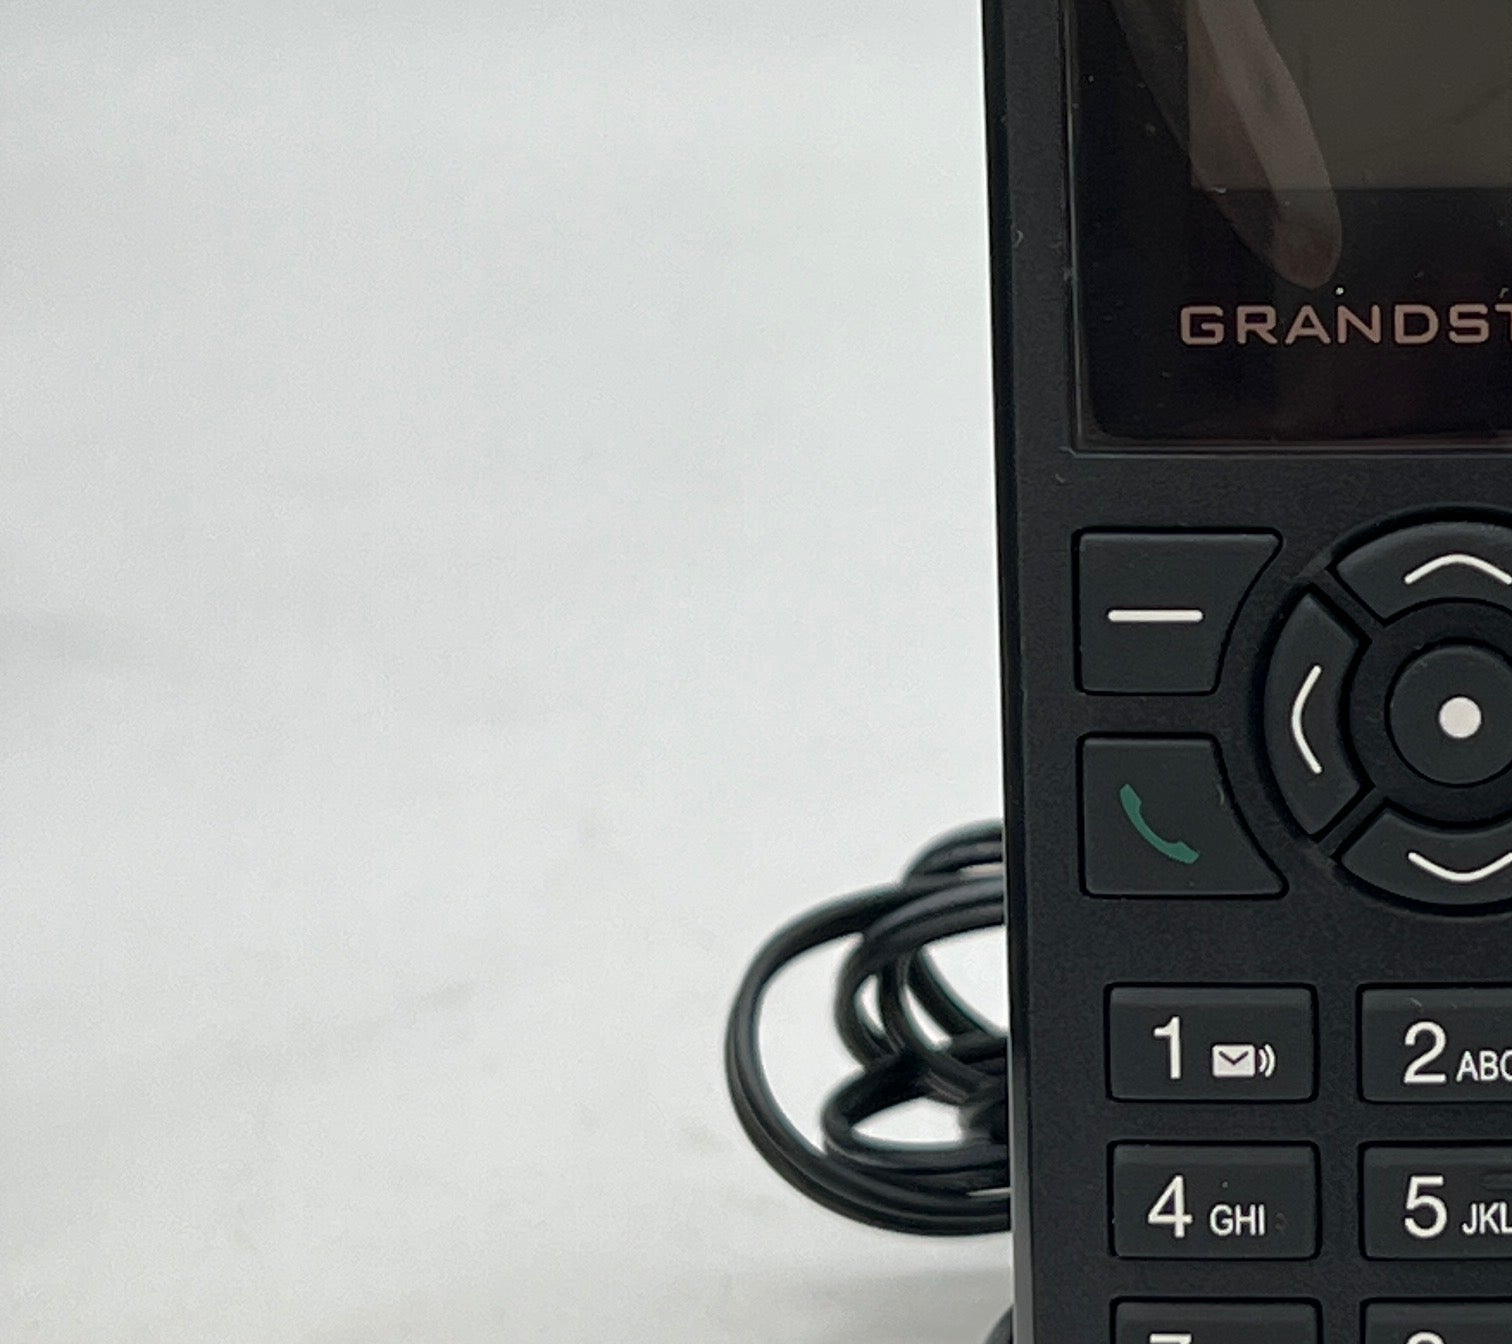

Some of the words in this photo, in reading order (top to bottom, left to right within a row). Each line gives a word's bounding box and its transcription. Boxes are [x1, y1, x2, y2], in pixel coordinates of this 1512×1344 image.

[1155, 1017, 1182, 1080] 1
[1404, 1022, 1448, 1085] 2
[1148, 1176, 1194, 1239] 4
[1210, 1205, 1266, 1237] GHI
[1405, 1176, 1449, 1239] 5
